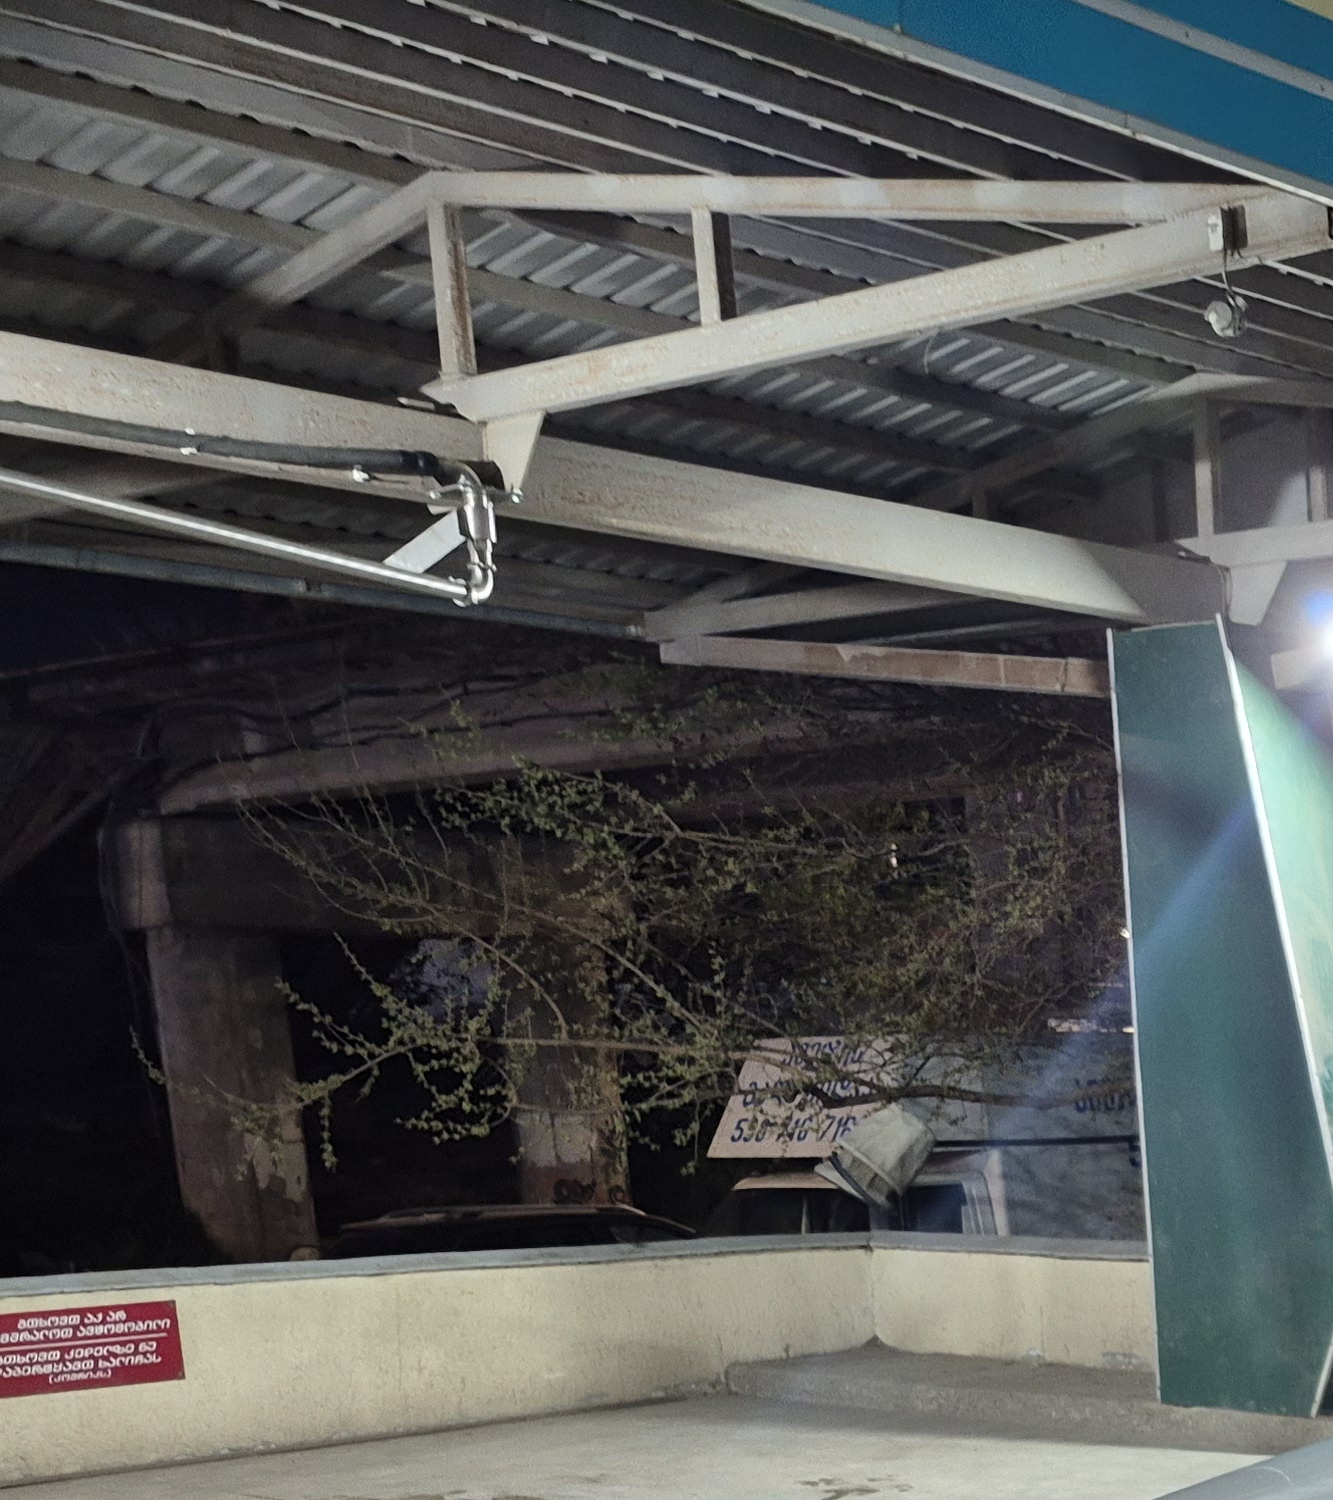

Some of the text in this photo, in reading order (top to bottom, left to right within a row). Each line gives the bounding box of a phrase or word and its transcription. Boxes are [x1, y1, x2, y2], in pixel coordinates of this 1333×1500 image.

[17, 1314, 80, 1330] გთხოვთ
[106, 1310, 127, 1322] არ
[77, 1318, 170, 1337] ავტომობილი
[65, 1343, 135, 1360] კედელზე
[138, 1341, 157, 1353] ნუ
[98, 1353, 162, 1369] ხალიჩას
